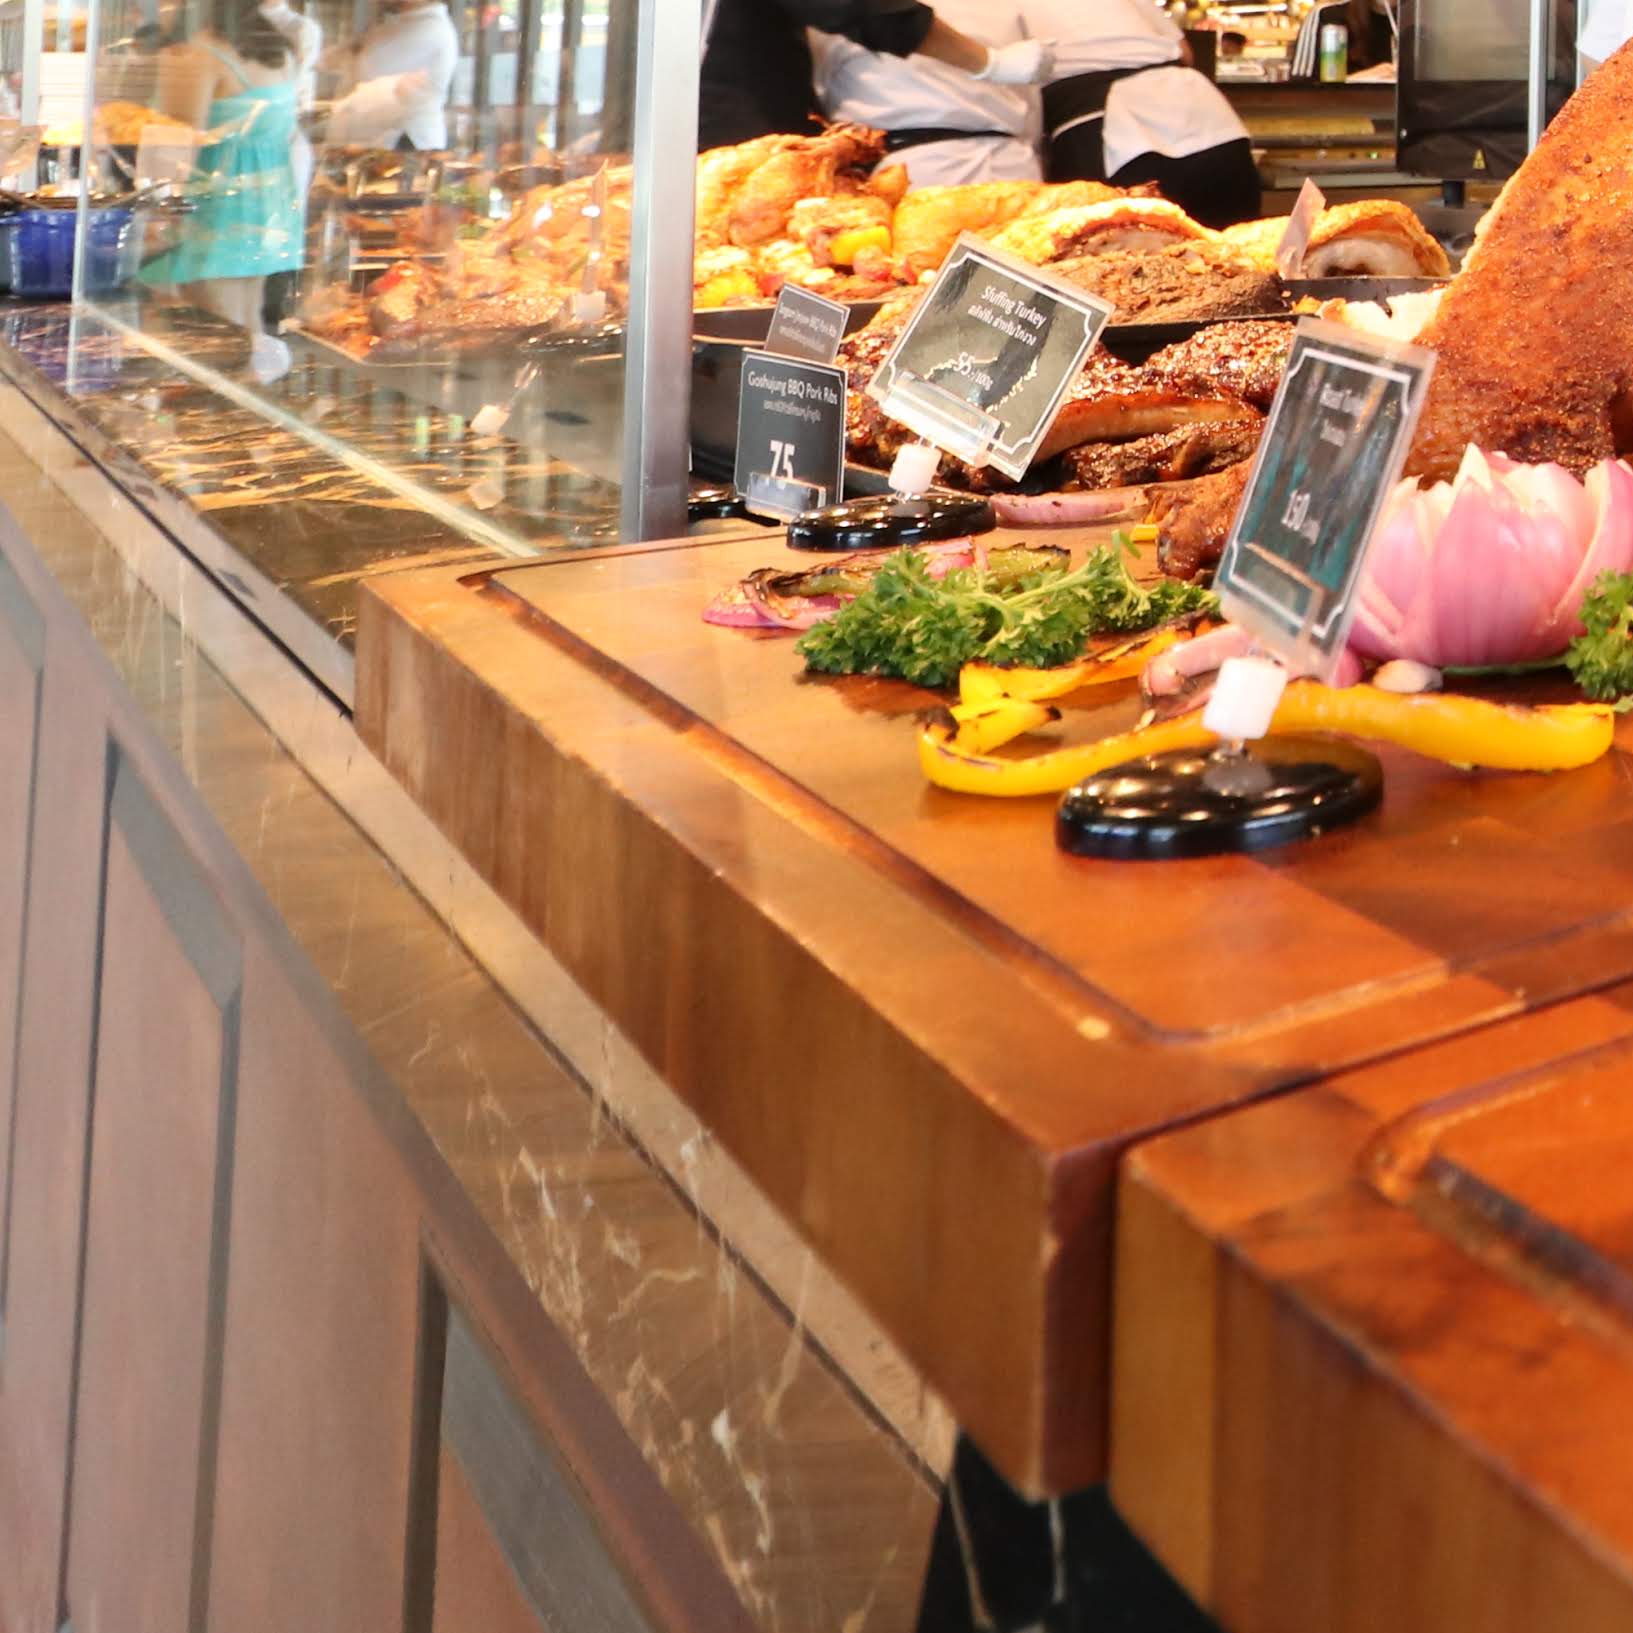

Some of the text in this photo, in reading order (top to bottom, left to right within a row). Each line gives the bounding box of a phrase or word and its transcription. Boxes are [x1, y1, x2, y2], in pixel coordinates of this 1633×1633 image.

[980, 286, 1047, 329] Stuffing Turkey
[787, 377, 805, 399] BBQ
[805, 381, 823, 400] Pork
[823, 386, 838, 405] Ribs
